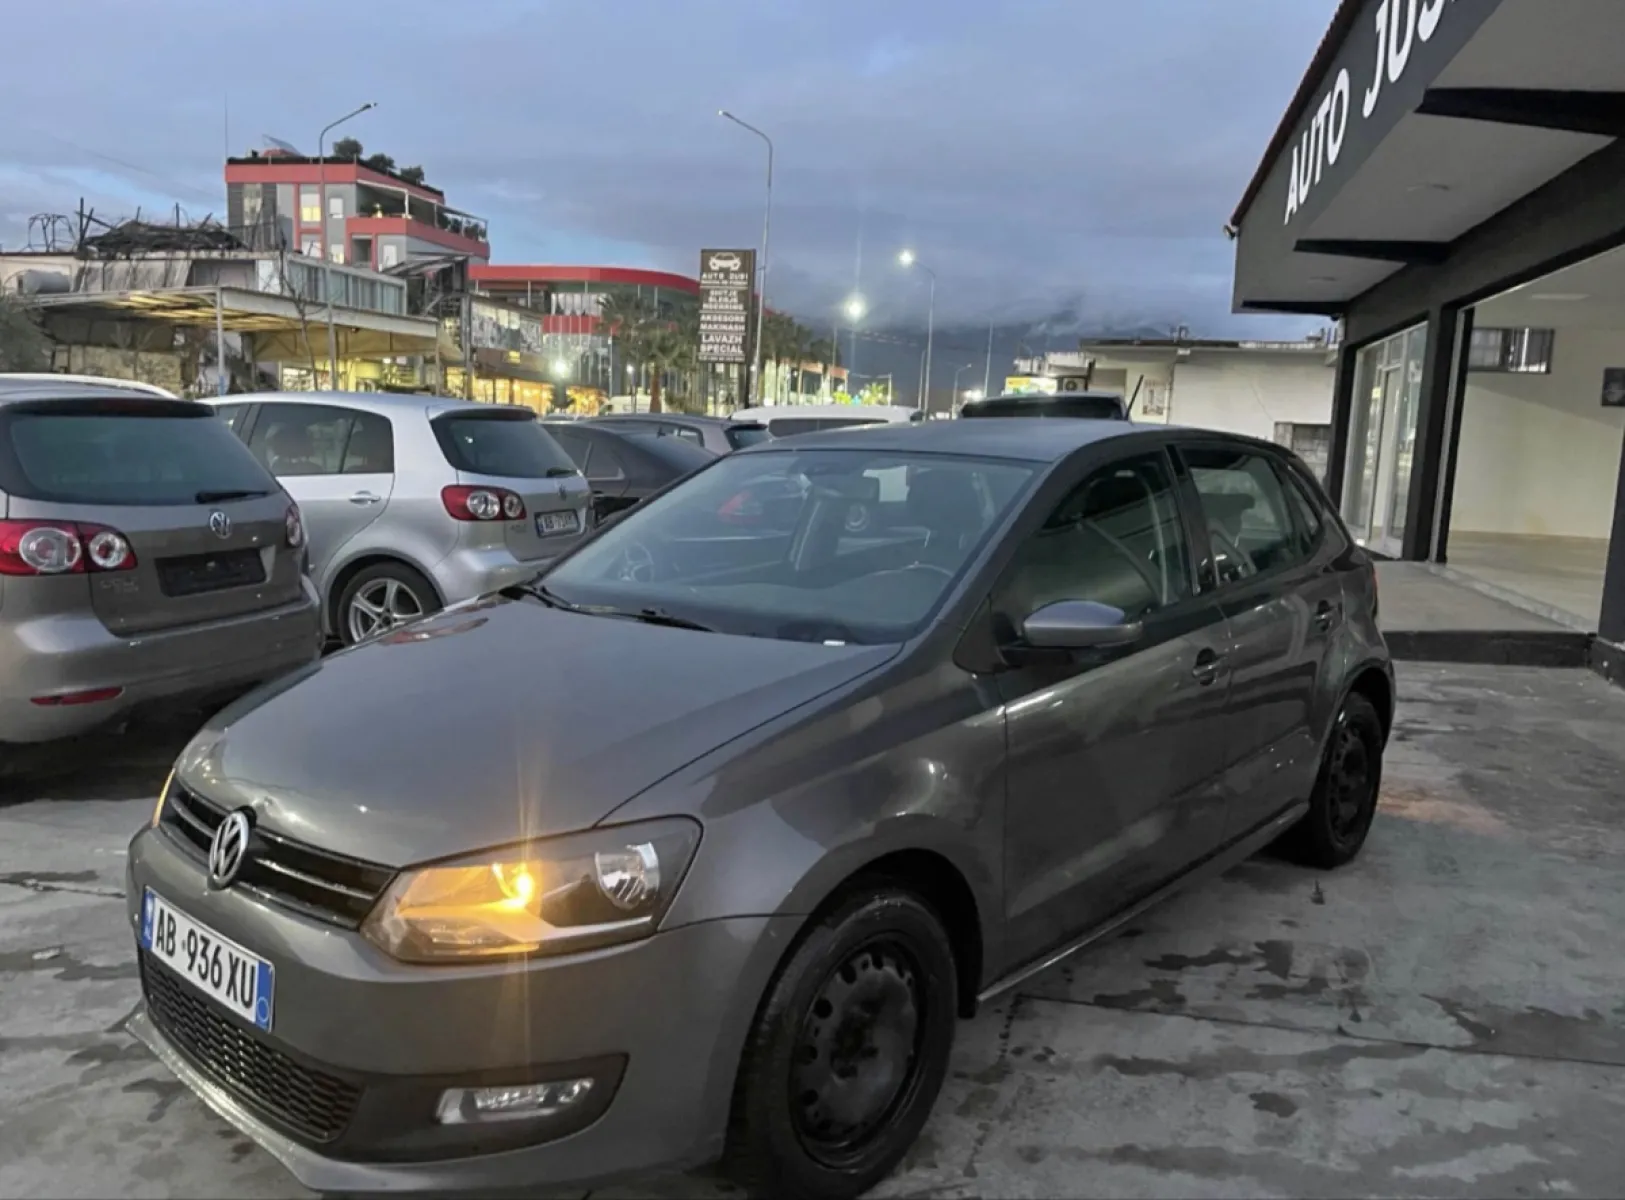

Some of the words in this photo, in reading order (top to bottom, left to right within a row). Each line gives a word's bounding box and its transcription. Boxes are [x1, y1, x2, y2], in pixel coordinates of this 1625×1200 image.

[1284, 68, 1350, 225] AUTO
[700, 323, 745, 332] MAKINASH
[702, 335, 743, 344] LAVAZH
[700, 344, 743, 353] SPECIAL
[156, 908, 177, 958] AB
[187, 928, 222, 989] 936
[226, 951, 256, 1009] XU
